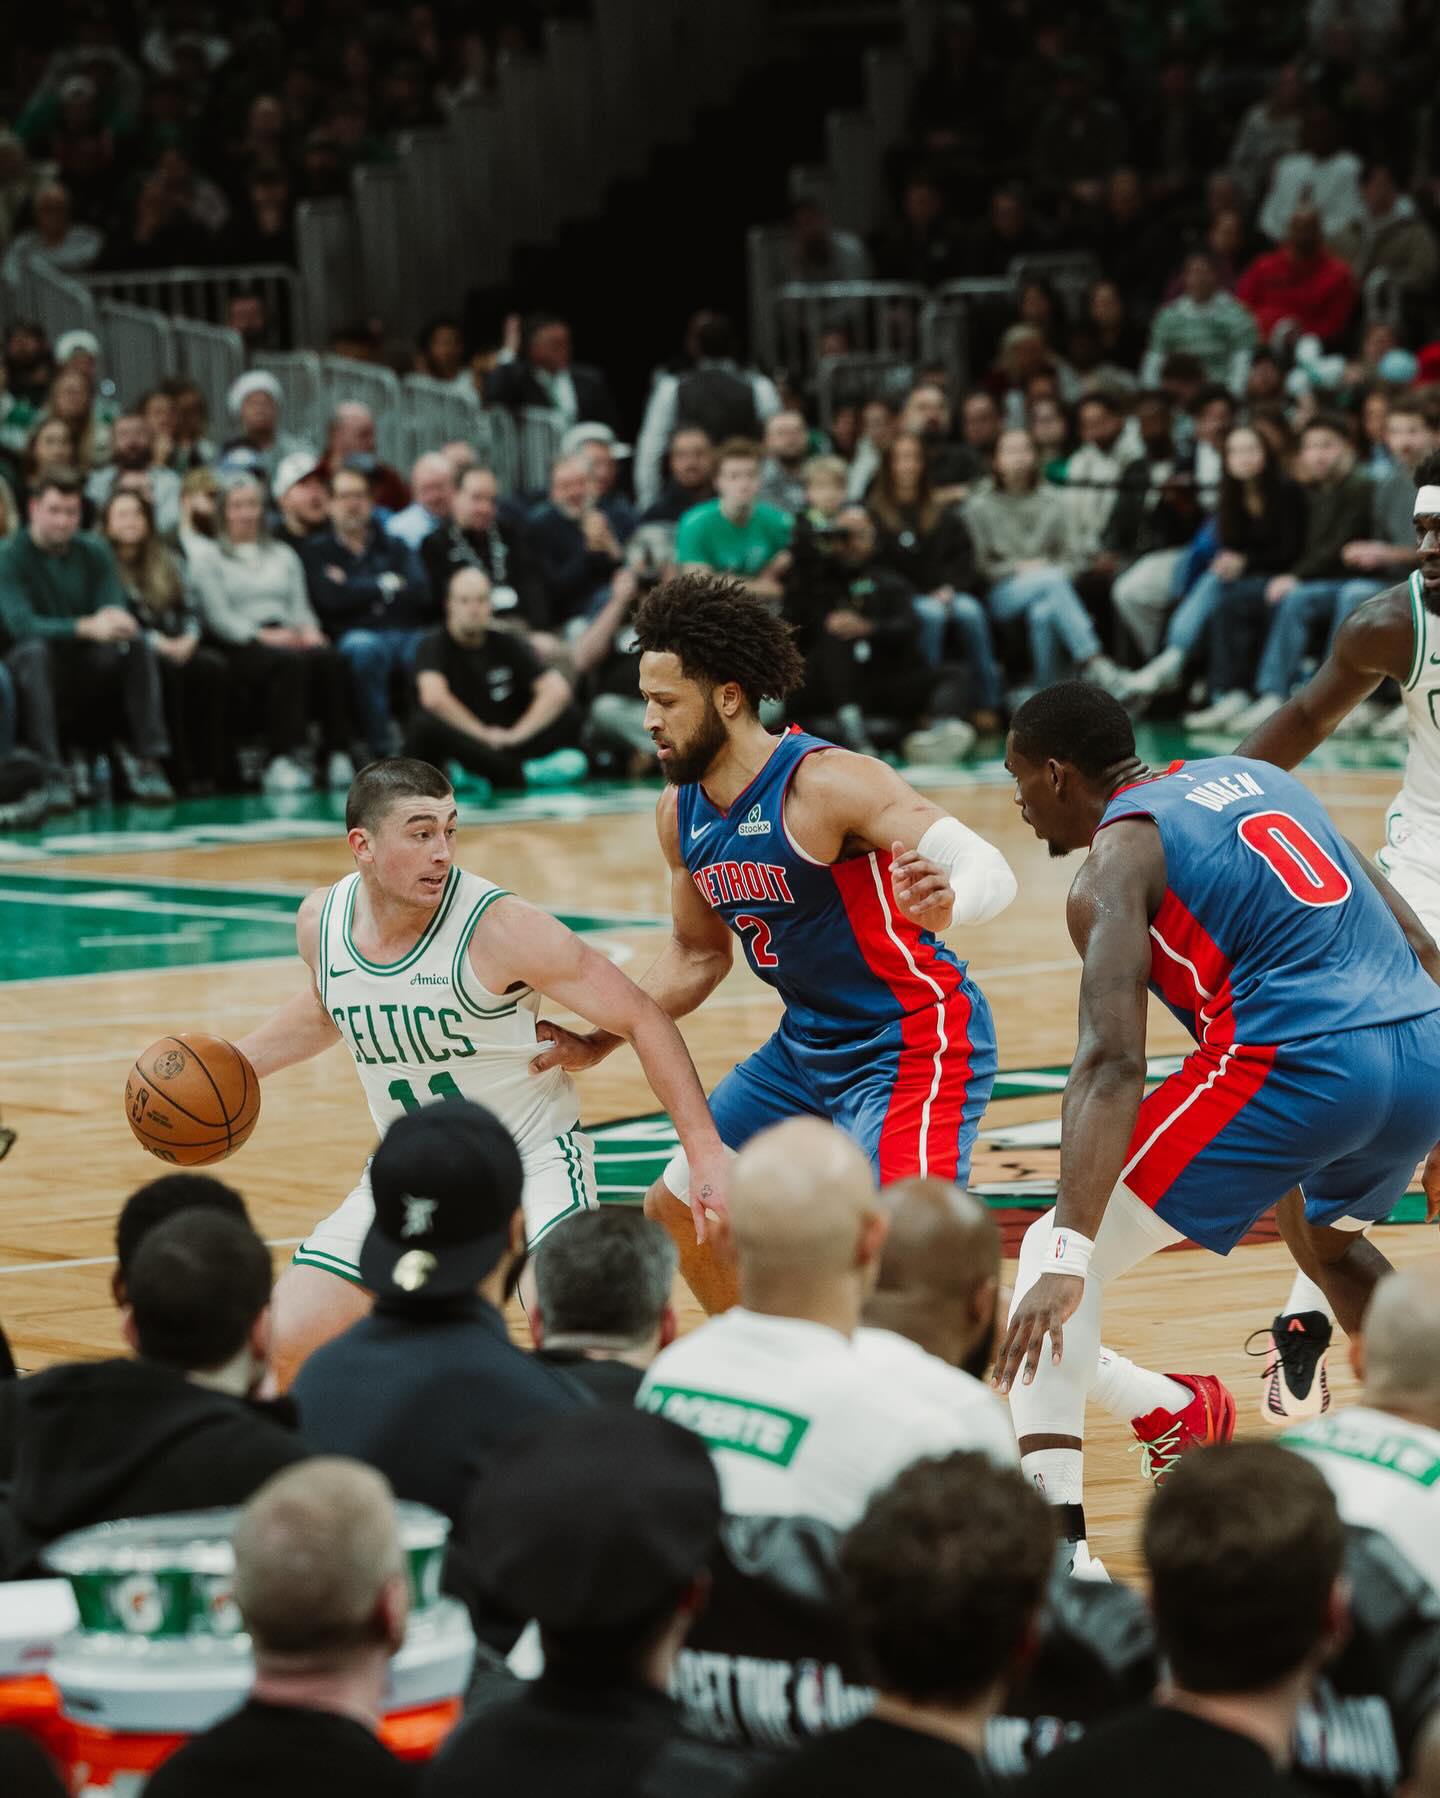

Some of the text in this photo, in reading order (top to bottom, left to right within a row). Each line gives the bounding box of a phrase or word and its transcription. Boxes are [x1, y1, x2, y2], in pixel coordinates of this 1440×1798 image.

[1185, 772, 1264, 812] DUREN
[740, 823, 769, 834] StockX
[1237, 810, 1353, 907] 0
[693, 860, 795, 908] DETROIT
[735, 914, 779, 967] 2
[410, 973, 449, 985] Amica
